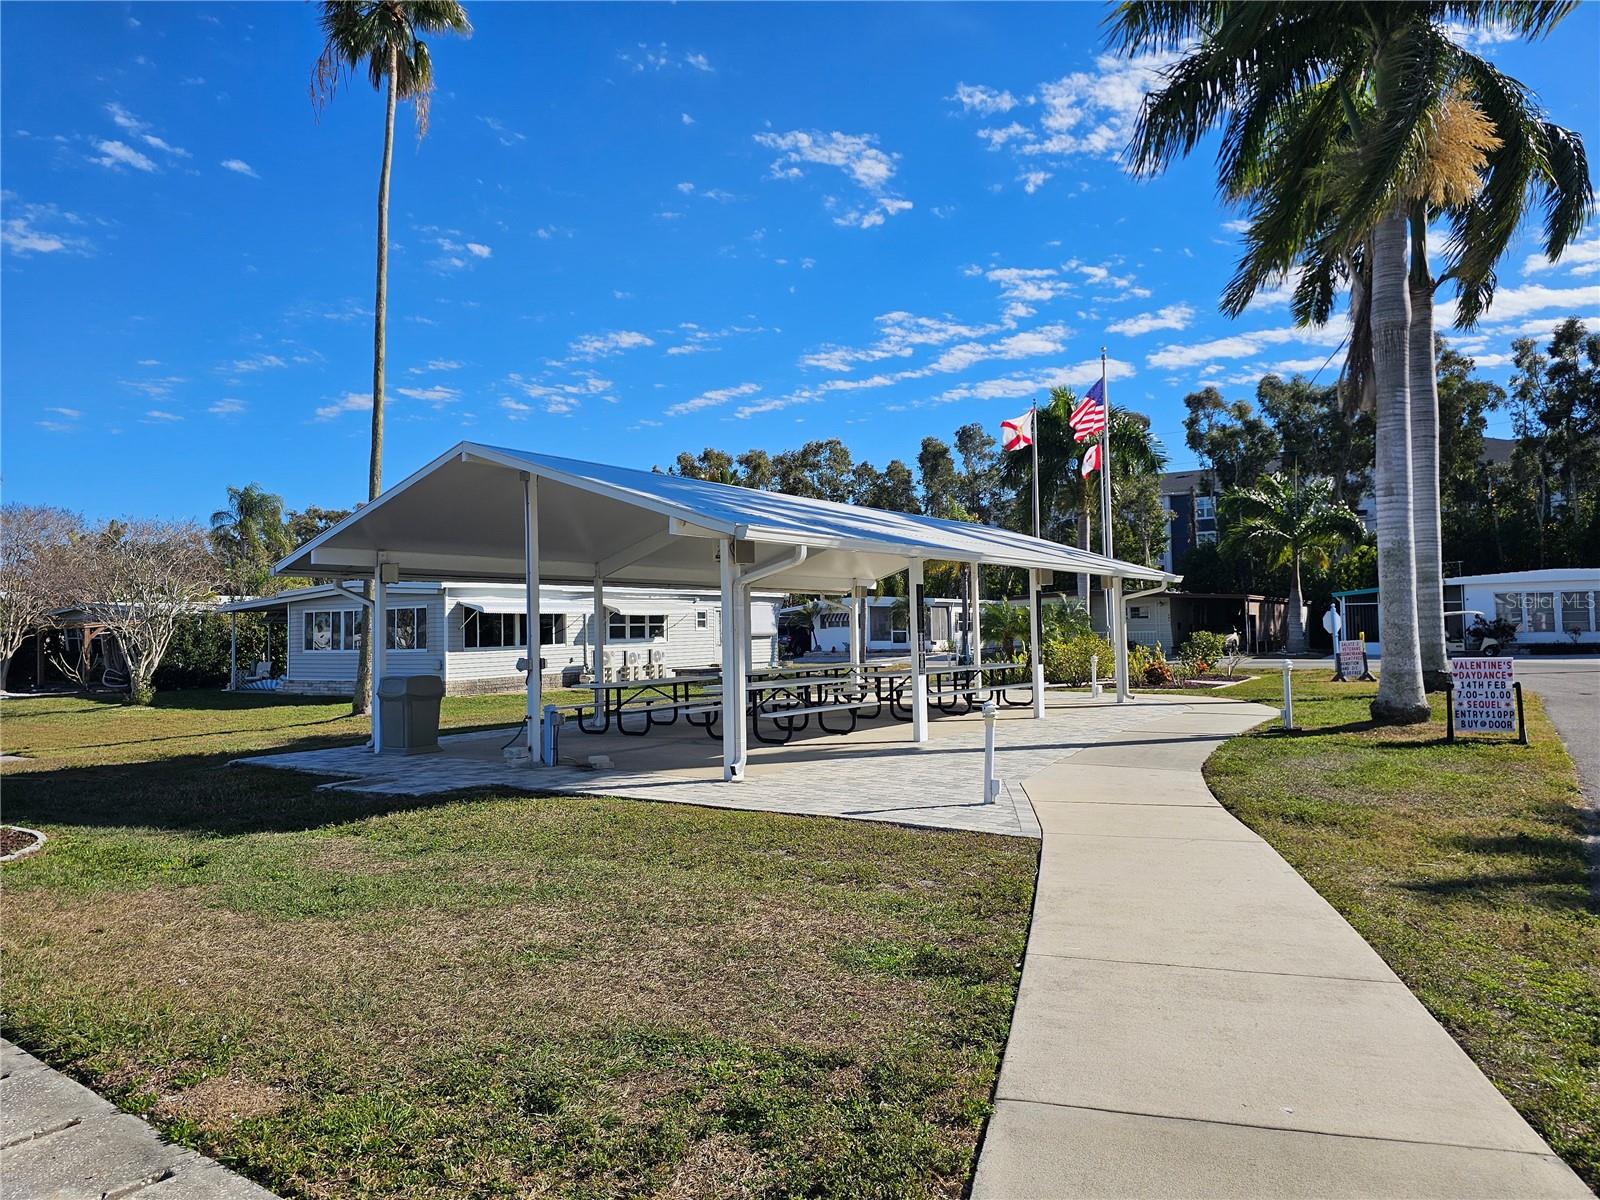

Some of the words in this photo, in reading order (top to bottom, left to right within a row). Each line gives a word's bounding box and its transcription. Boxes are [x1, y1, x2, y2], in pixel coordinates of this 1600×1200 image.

[1453, 661, 1512, 669] VALENTINE'S
[1459, 671, 1506, 680] DAYDANCE
[1461, 681, 1484, 689] 14TH
[1487, 681, 1506, 689] FEB
[1457, 691, 1511, 699] 7.00-10.00
[1467, 700, 1502, 709] SEQUEL
